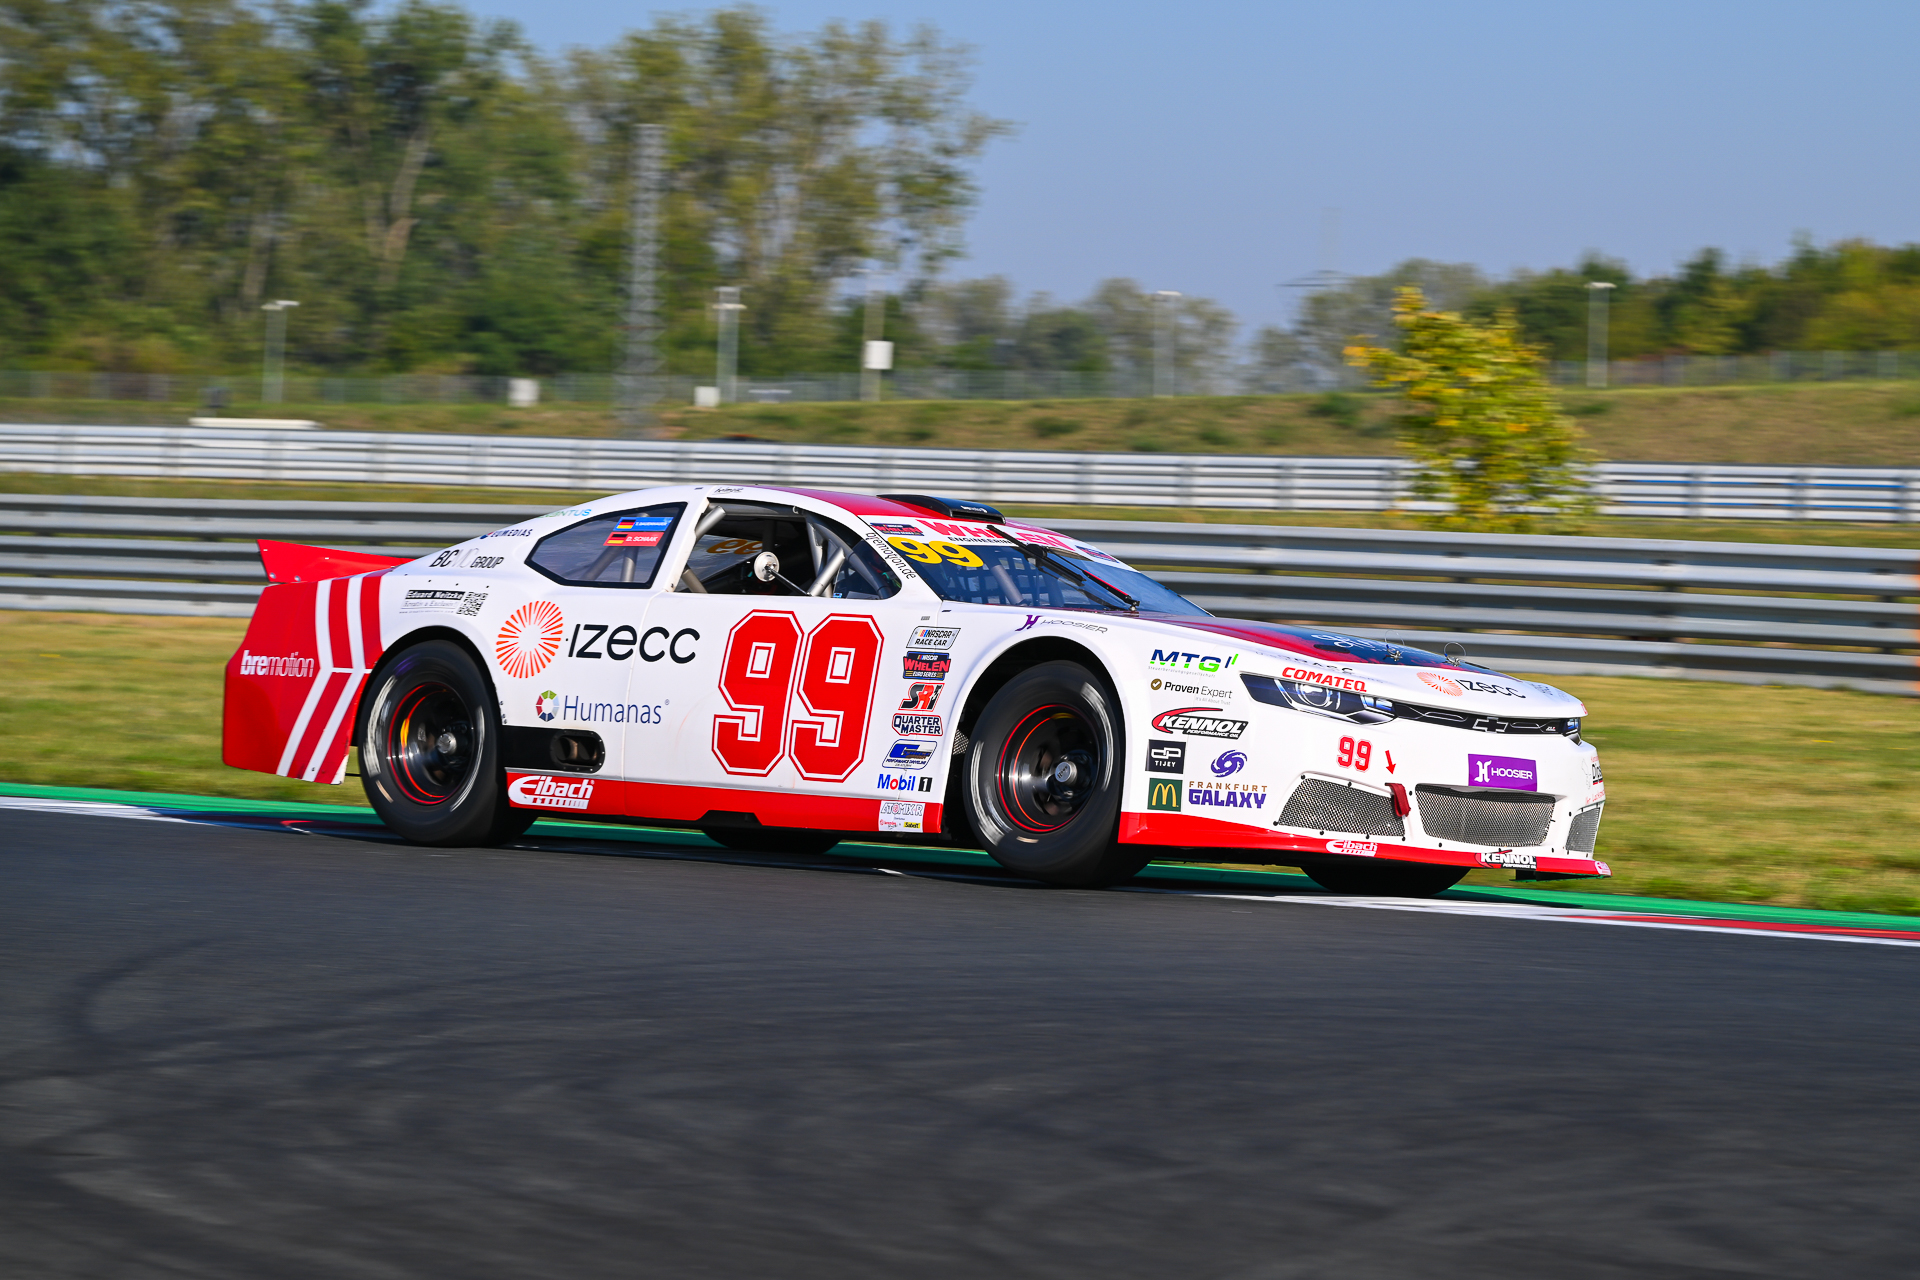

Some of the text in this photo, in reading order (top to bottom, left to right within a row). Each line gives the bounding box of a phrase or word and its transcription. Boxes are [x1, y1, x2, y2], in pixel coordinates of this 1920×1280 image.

[915, 519, 1076, 551] WHEN
[887, 536, 985, 568] 99
[926, 630, 952, 639] NASCAR
[1040, 619, 1109, 634] HOOSIER
[914, 638, 948, 647] RACE CAR
[240, 650, 315, 677] bremotion
[903, 658, 951, 673] WHELEN
[1150, 649, 1222, 673] MTG
[1281, 667, 1367, 692] COMATEQ
[711, 609, 885, 783] 99
[1164, 681, 1233, 699] Proven Expert
[893, 715, 940, 728] QUARTER
[900, 724, 941, 735] MASTER
[1158, 715, 1244, 734] KENNOL
[1336, 735, 1373, 773] 99
[1155, 760, 1176, 768] TIJEY
[1491, 767, 1533, 780] HOOSIER
[877, 774, 916, 791] Mobil
[1188, 781, 1268, 792] FRANKFURT
[508, 775, 594, 809] Eibach
[1188, 789, 1267, 809] GALAXY
[1480, 852, 1537, 866] KENNOL
